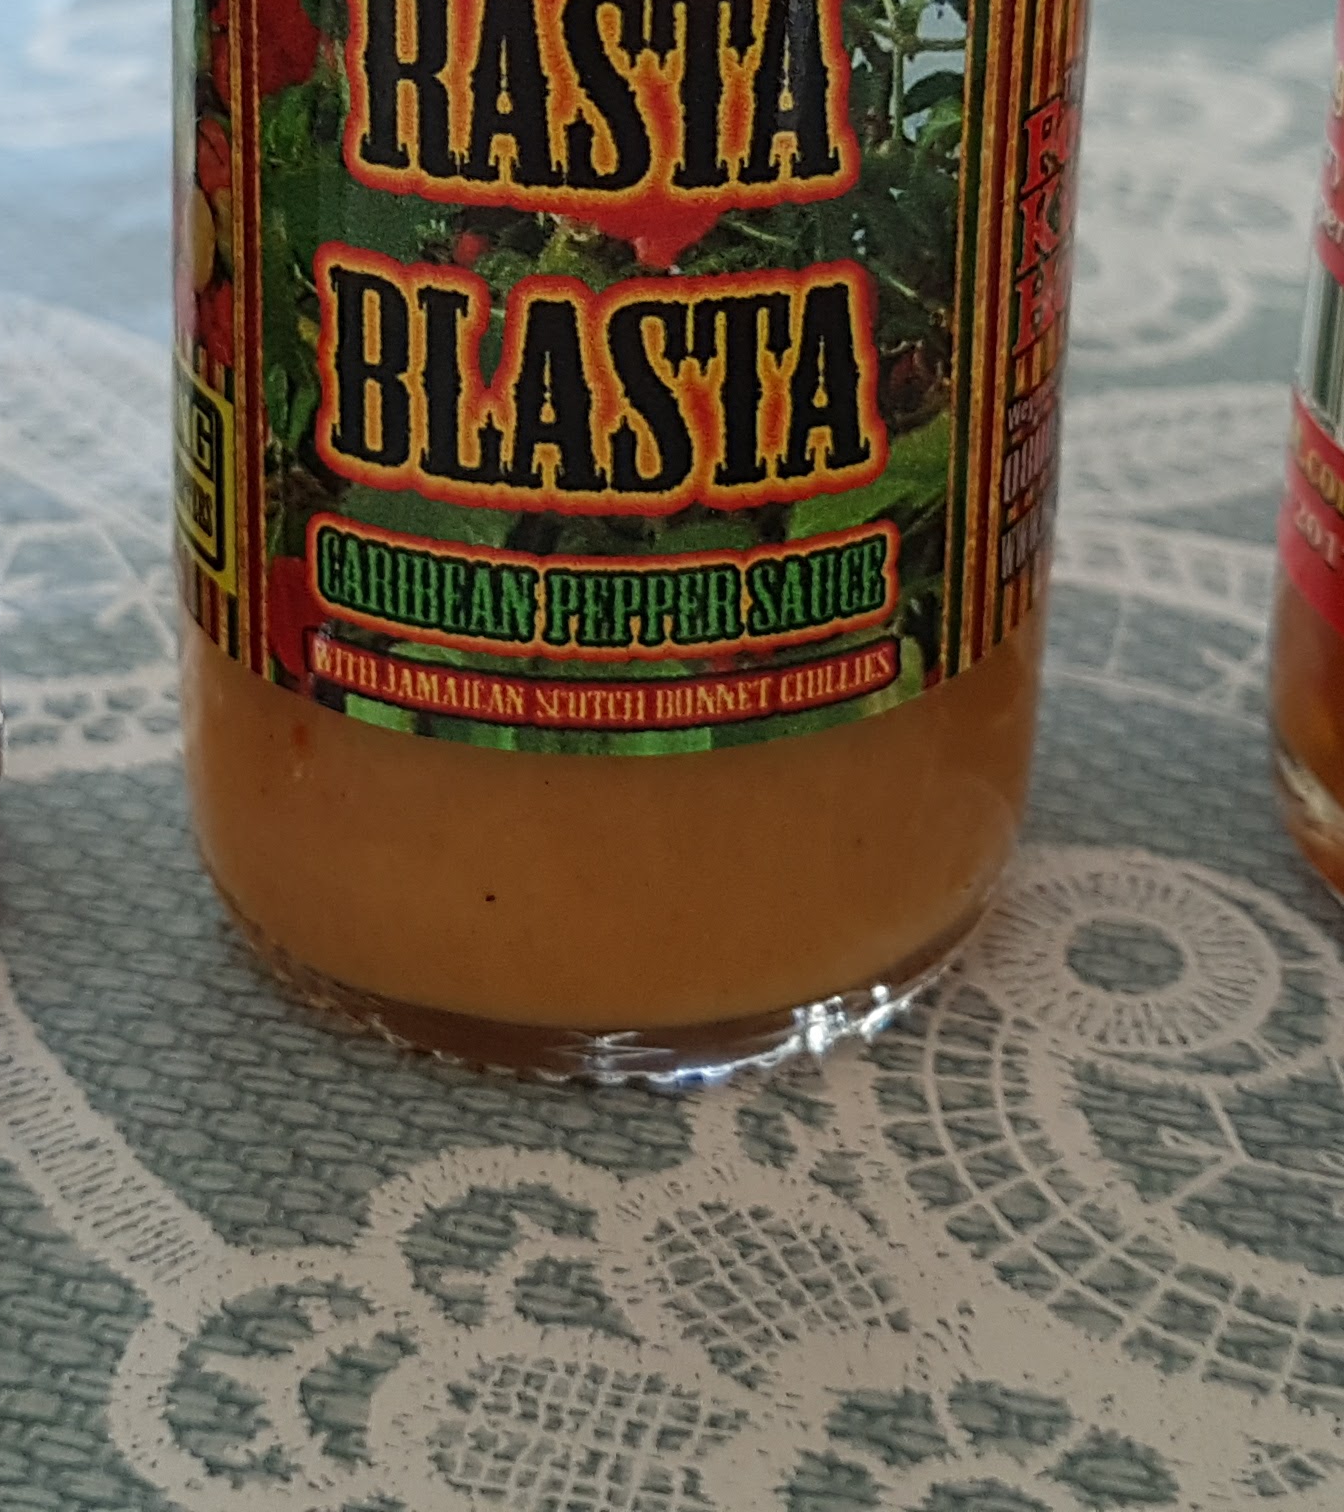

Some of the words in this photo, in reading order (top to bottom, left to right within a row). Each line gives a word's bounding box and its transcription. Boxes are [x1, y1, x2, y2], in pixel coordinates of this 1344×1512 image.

[325, 264, 874, 496] BLASTA
[544, 565, 744, 648] PEPPER
[747, 532, 890, 632] SAUCE
[313, 639, 380, 690] WITH
[381, 655, 527, 719] JAMAICAN
[535, 687, 648, 724] SCOTCH
[655, 678, 770, 719] BONNET
[778, 645, 895, 705] CHILLIES
